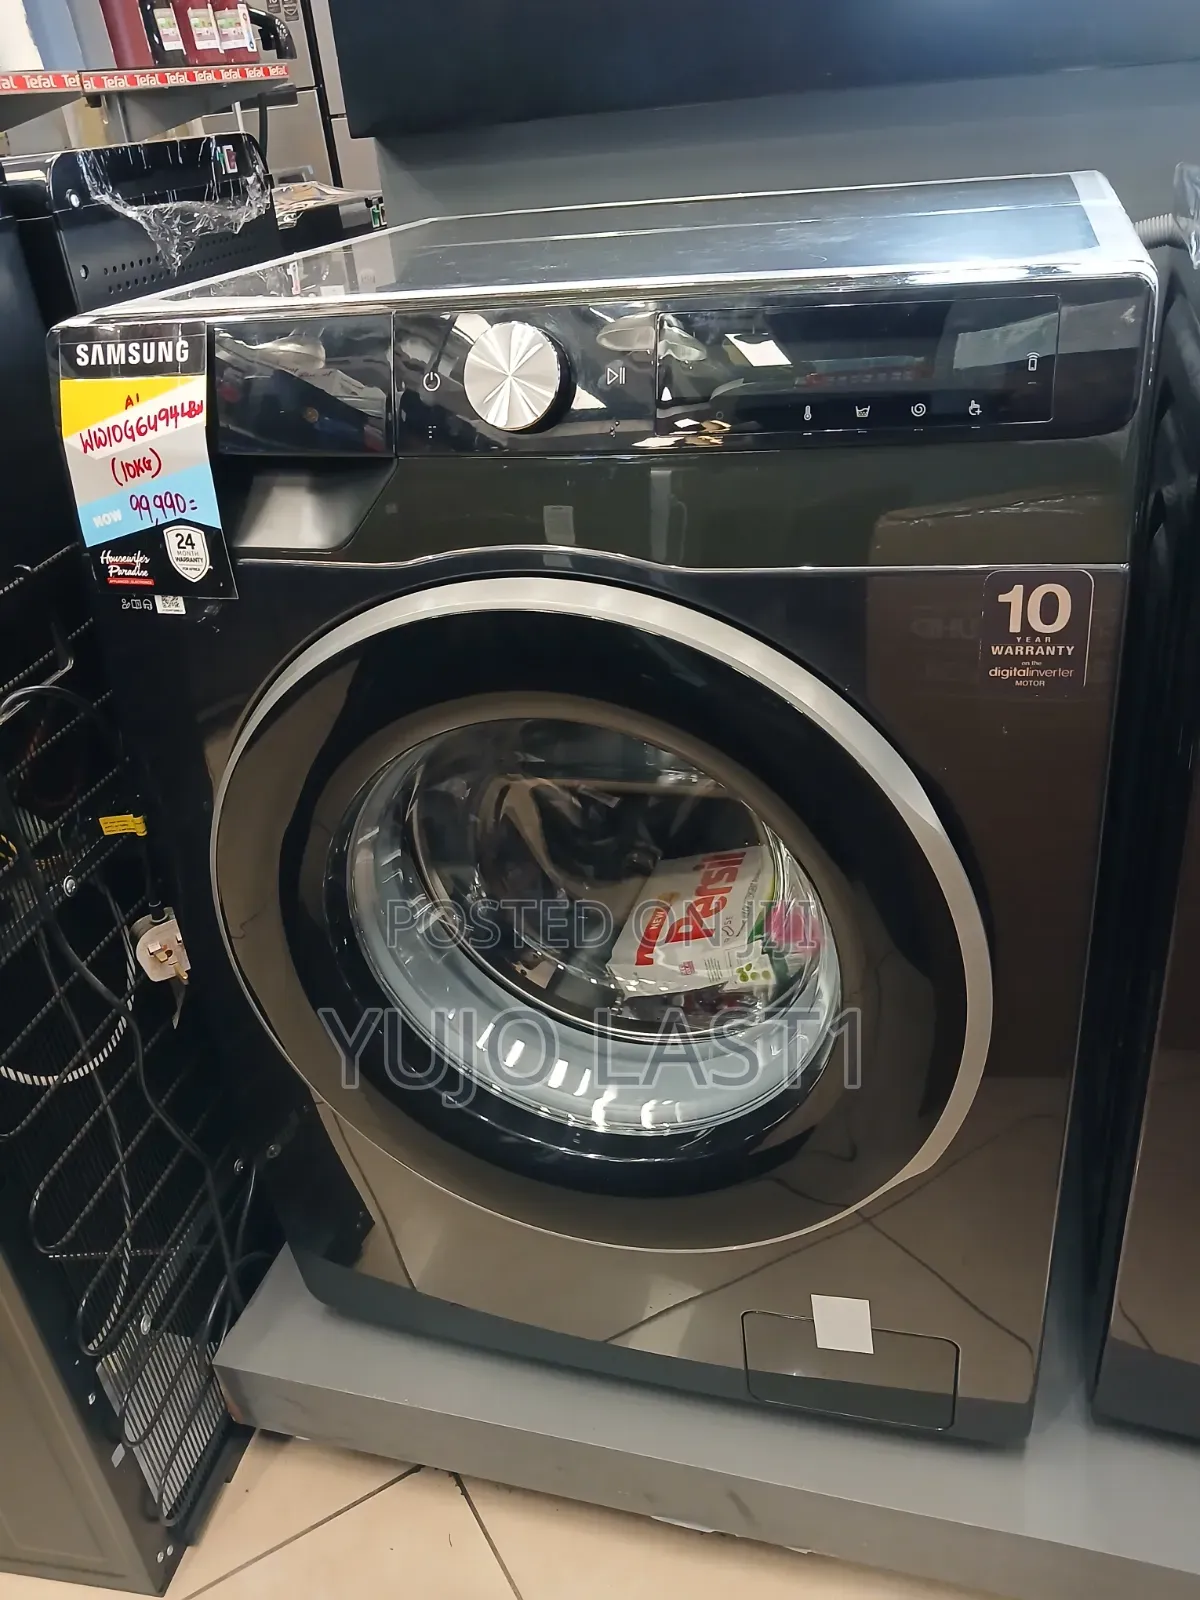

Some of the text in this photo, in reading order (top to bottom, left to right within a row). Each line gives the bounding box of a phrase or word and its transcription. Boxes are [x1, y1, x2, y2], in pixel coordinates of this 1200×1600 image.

[22, 75, 57, 89] Tefal
[101, 75, 130, 88] Tefal
[134, 73, 160, 86] Tefal
[165, 72, 189, 84] Tefal
[194, 70, 217, 82] Tefal
[220, 69, 242, 80] Tefal
[245, 67, 264, 79] Tefal
[268, 65, 287, 77] Tefal
[76, 340, 189, 367] SAMSUNG
[92, 509, 122, 528] NOW
[175, 533, 195, 550] 24
[997, 583, 1072, 634] 10
[990, 645, 1075, 656] WARRANTY
[664, 851, 747, 943] Persil
